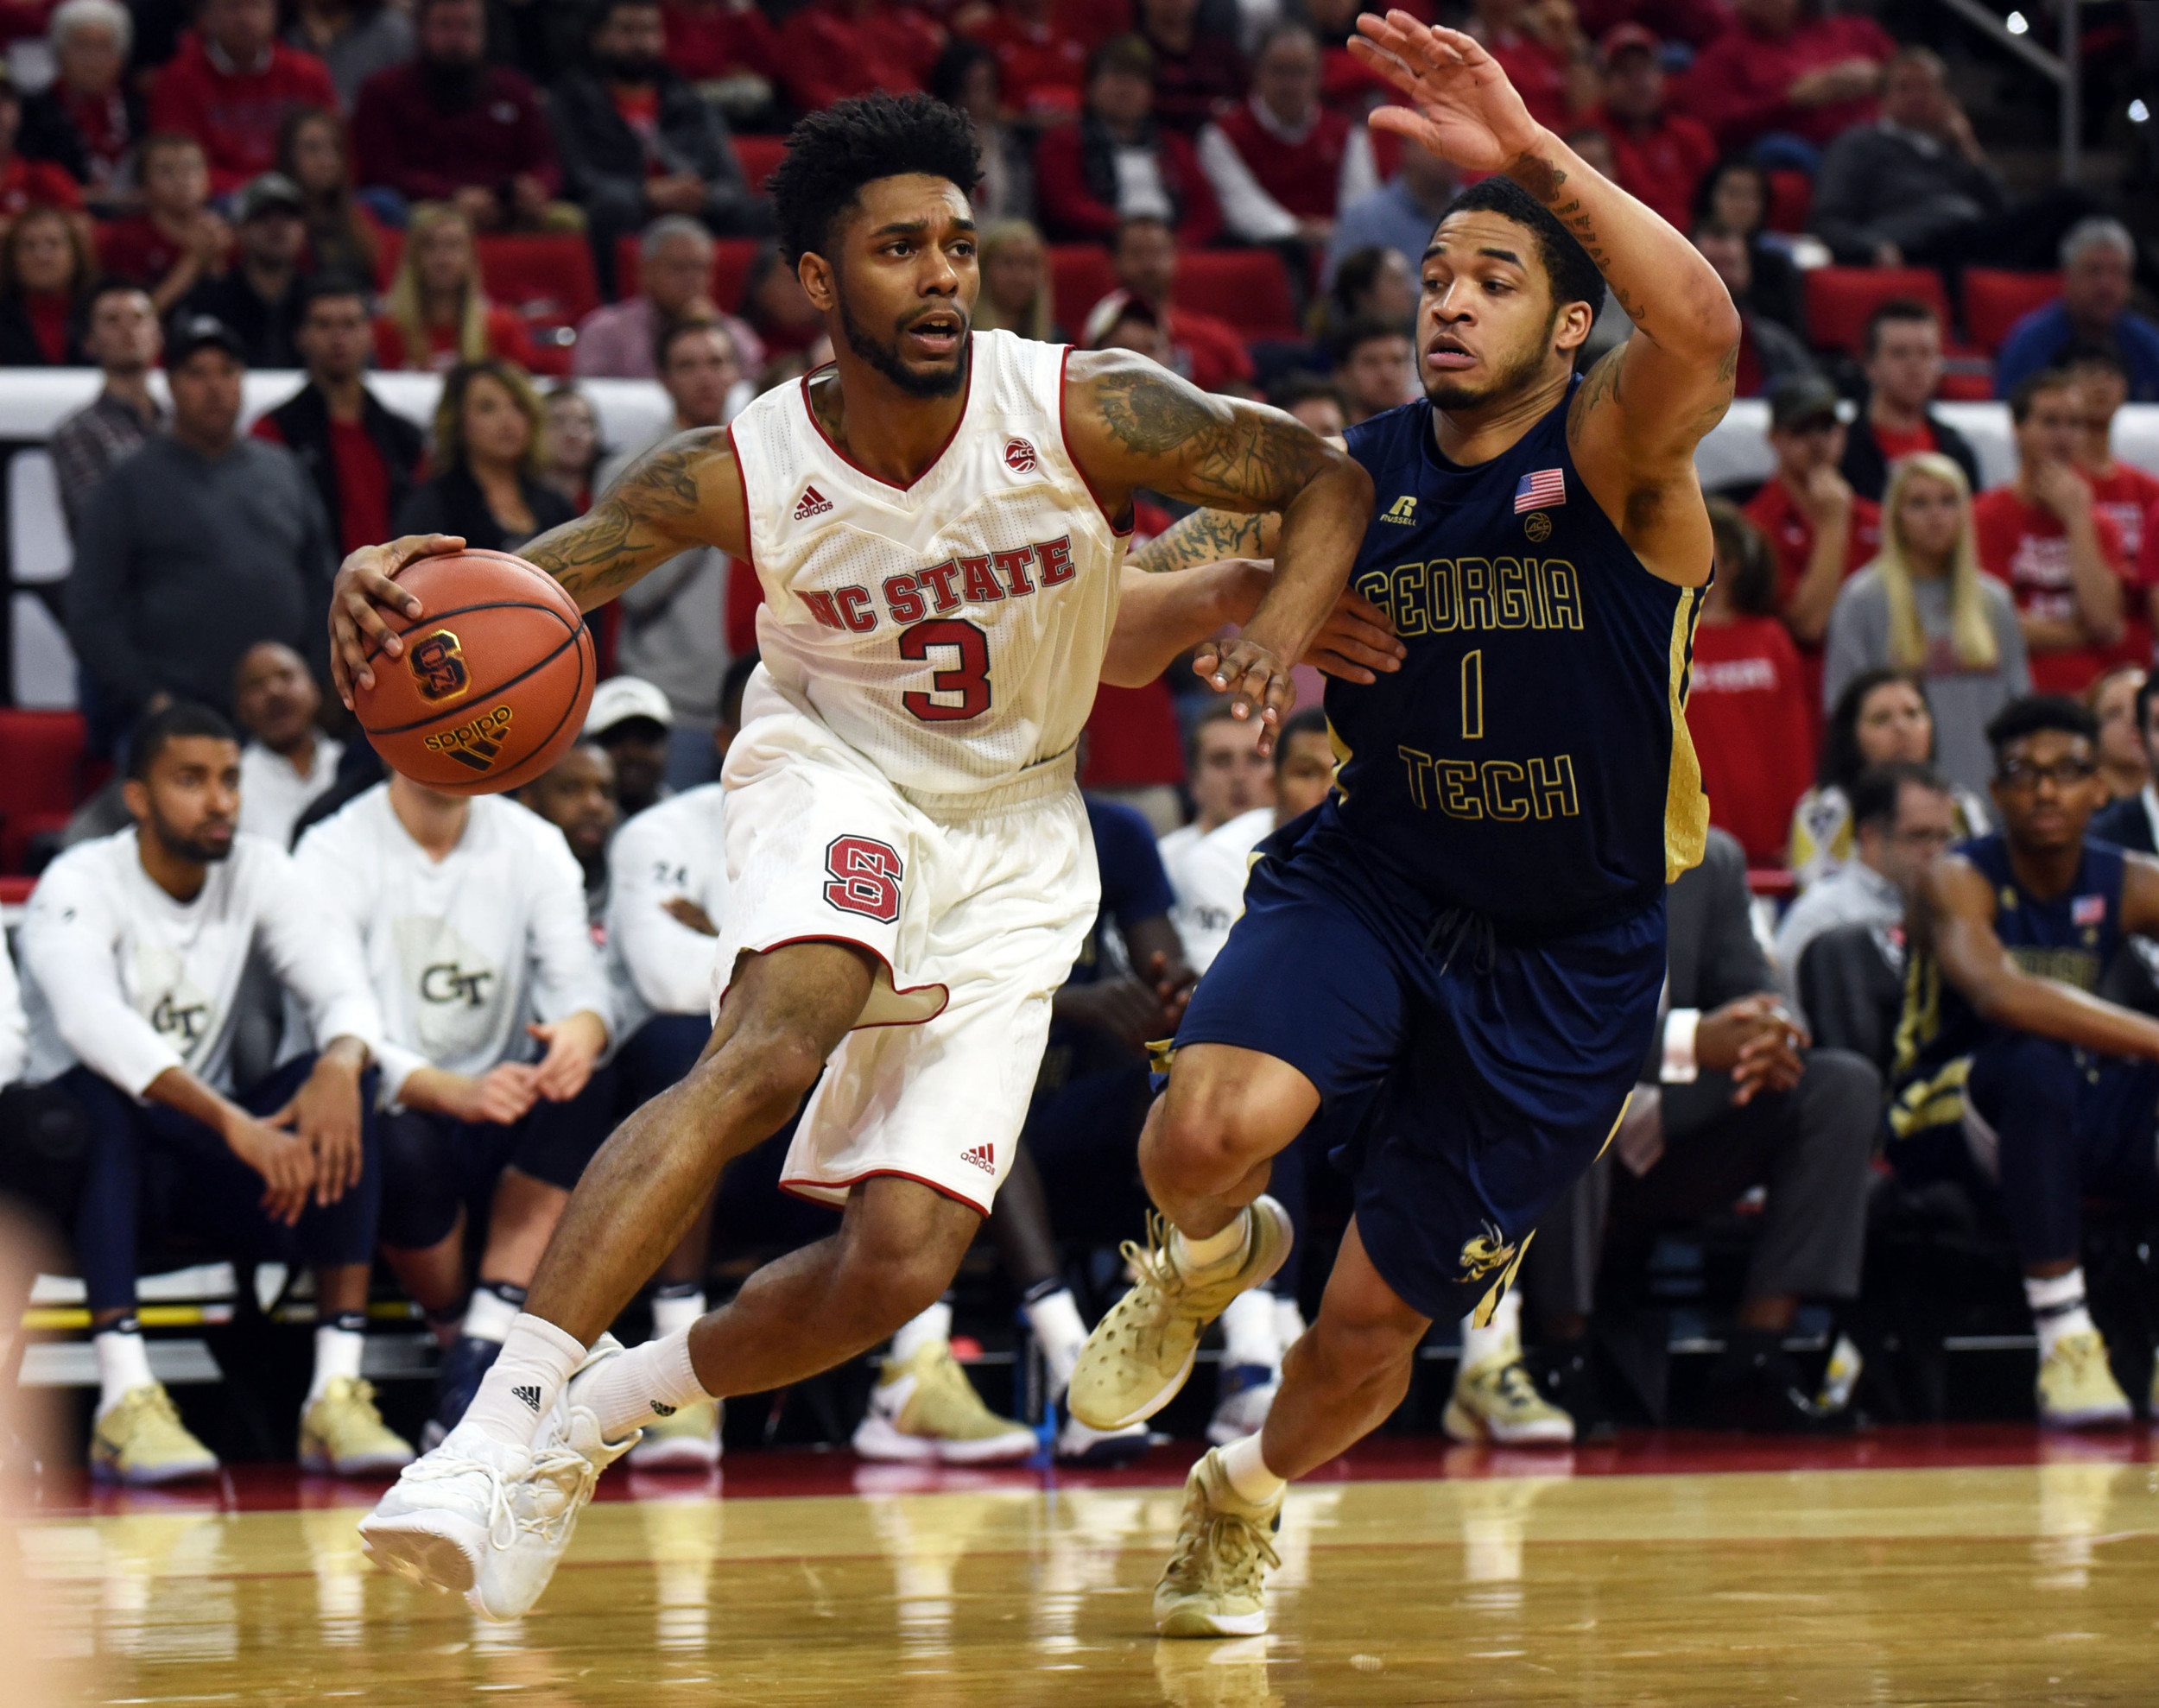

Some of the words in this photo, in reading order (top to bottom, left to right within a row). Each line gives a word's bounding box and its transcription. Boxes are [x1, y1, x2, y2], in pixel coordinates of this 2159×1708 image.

[1008, 447, 1035, 460] ACC
[794, 501, 833, 521] adidas
[1379, 514, 1417, 527] RUSSELL
[793, 585, 878, 633] NC
[882, 535, 1076, 625] STATE
[898, 618, 991, 721] 3
[1461, 648, 1483, 738] 1
[423, 705, 513, 752] adidas
[1397, 744, 1580, 822] TECH
[420, 960, 492, 1009] GT
[960, 1152, 995, 1175] adidas
